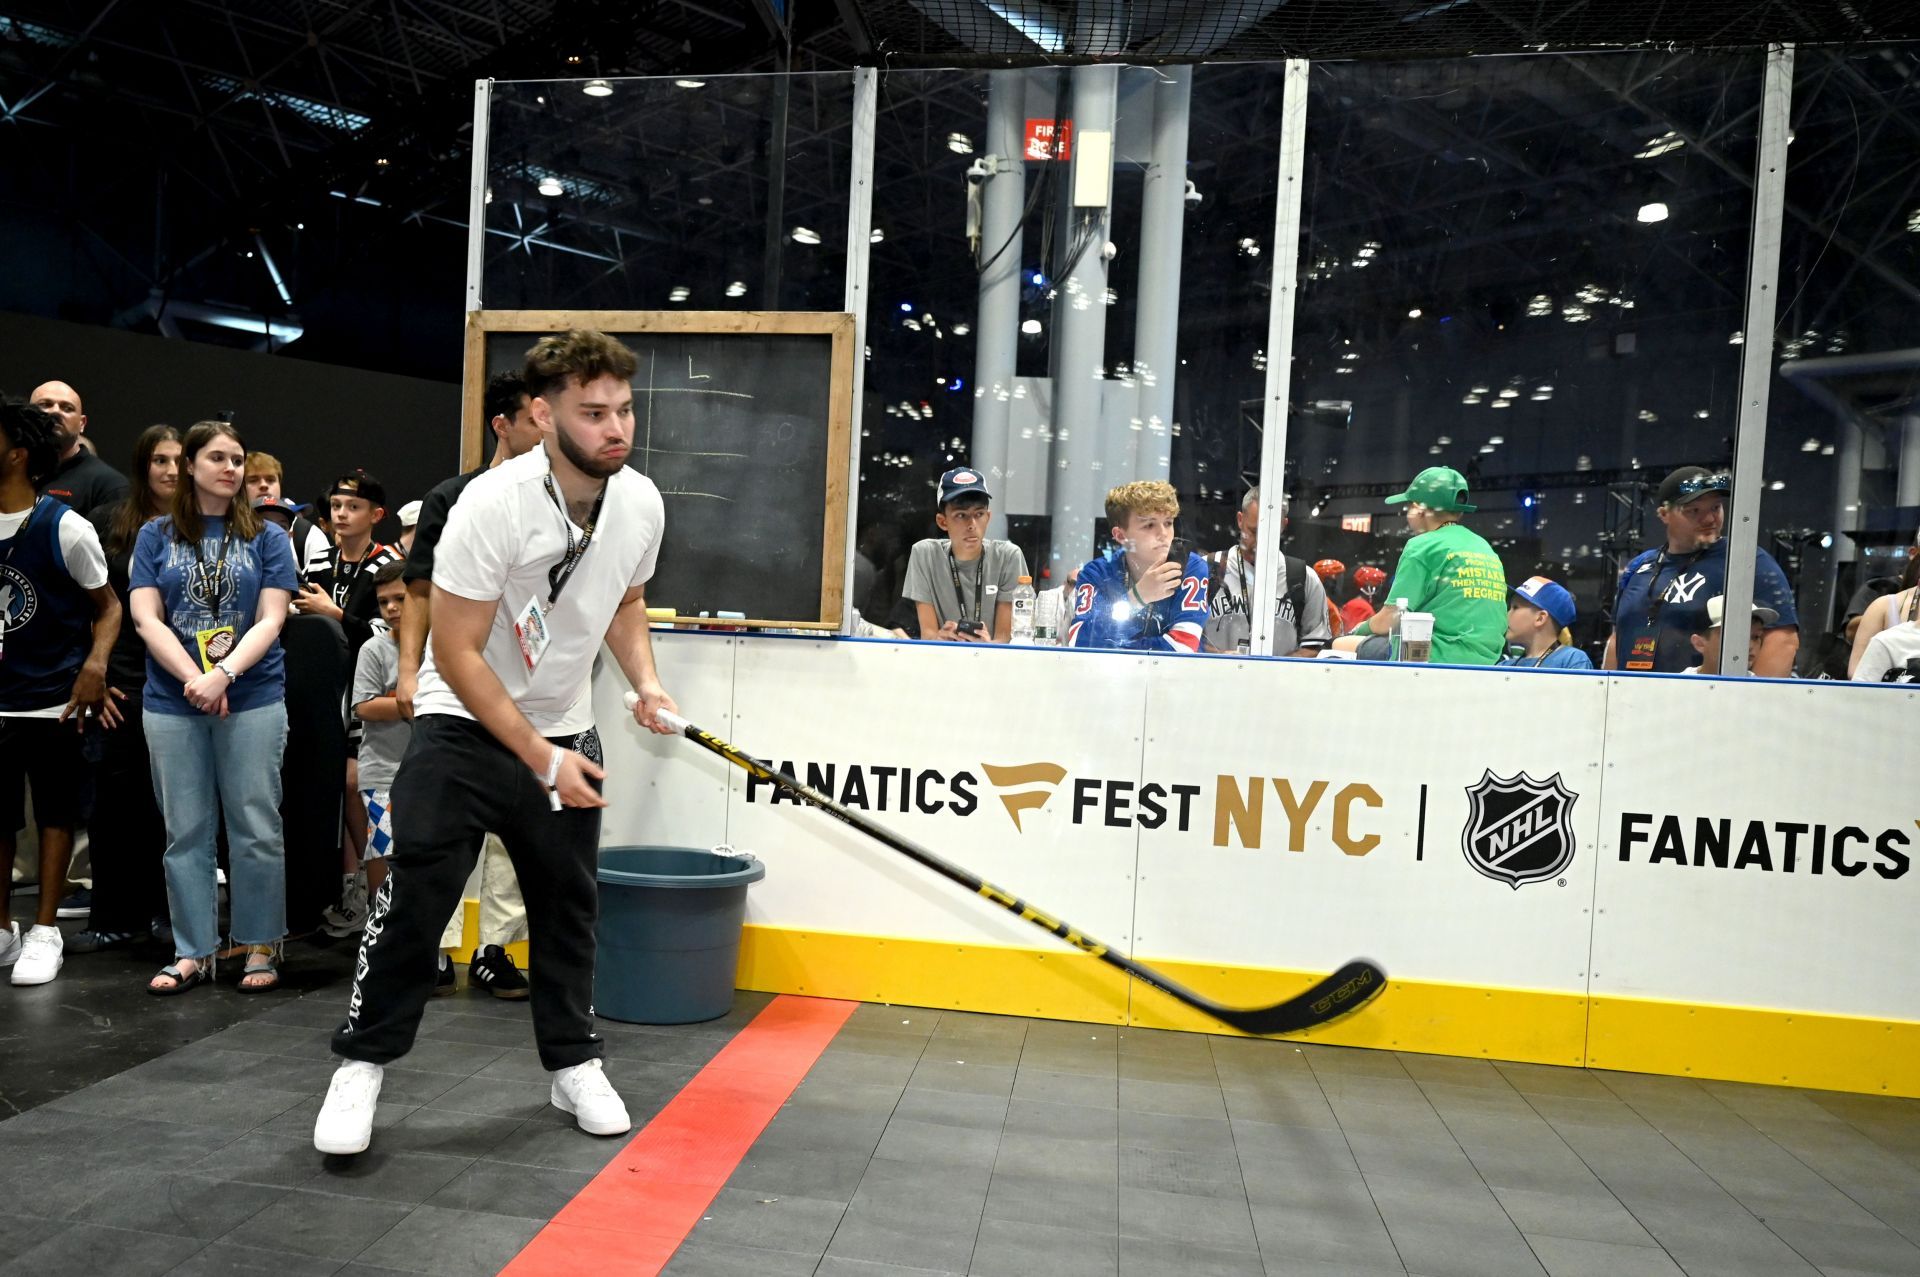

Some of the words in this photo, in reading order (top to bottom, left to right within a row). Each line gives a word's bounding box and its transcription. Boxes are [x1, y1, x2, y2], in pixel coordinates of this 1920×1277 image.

[1035, 125, 1062, 137] FIR
[746, 759, 978, 817] FANATICS
[1072, 778, 1201, 832] FEST
[1213, 774, 1383, 857] NYC
[1488, 804, 1553, 859] NHL
[1618, 812, 1911, 880] FANATICS
[1311, 968, 1373, 1015] CCM
